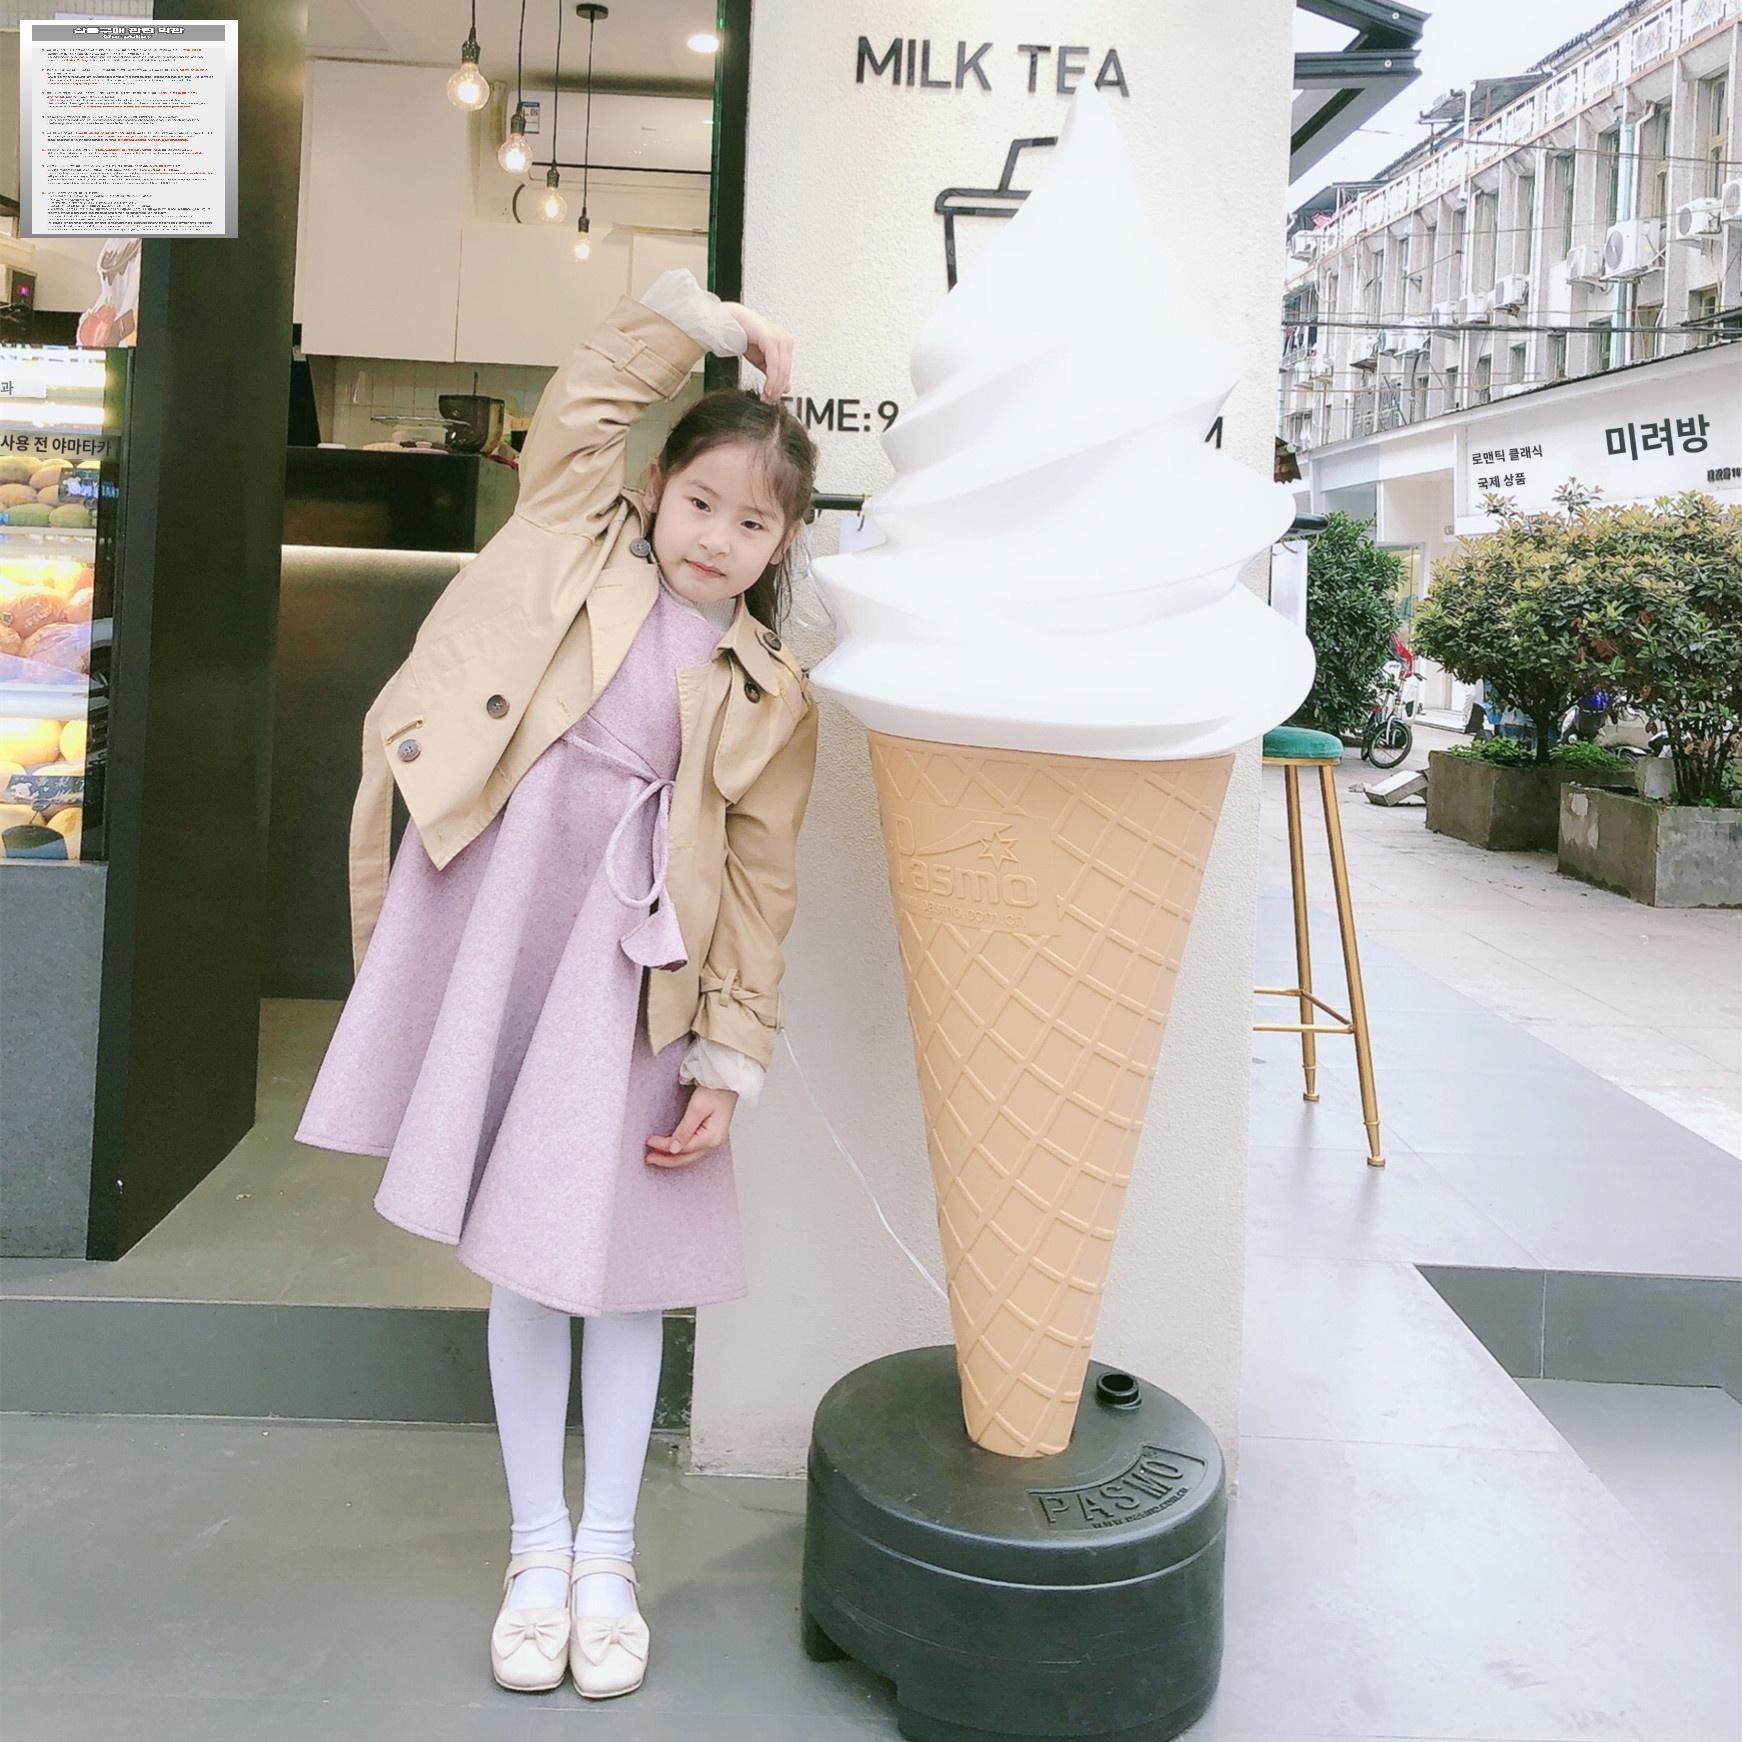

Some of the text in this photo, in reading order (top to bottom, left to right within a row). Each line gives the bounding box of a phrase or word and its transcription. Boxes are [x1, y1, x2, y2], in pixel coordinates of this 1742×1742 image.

[856, 36, 1130, 97] MILK TEA
[0, 434, 112, 456] 사용 전 야마타카
[1472, 444, 1543, 465] 로맨틱 클래식
[1605, 414, 1710, 461] 미려방
[1477, 472, 1526, 490] 국제 상품
[1038, 1459, 1183, 1524] PASMO
